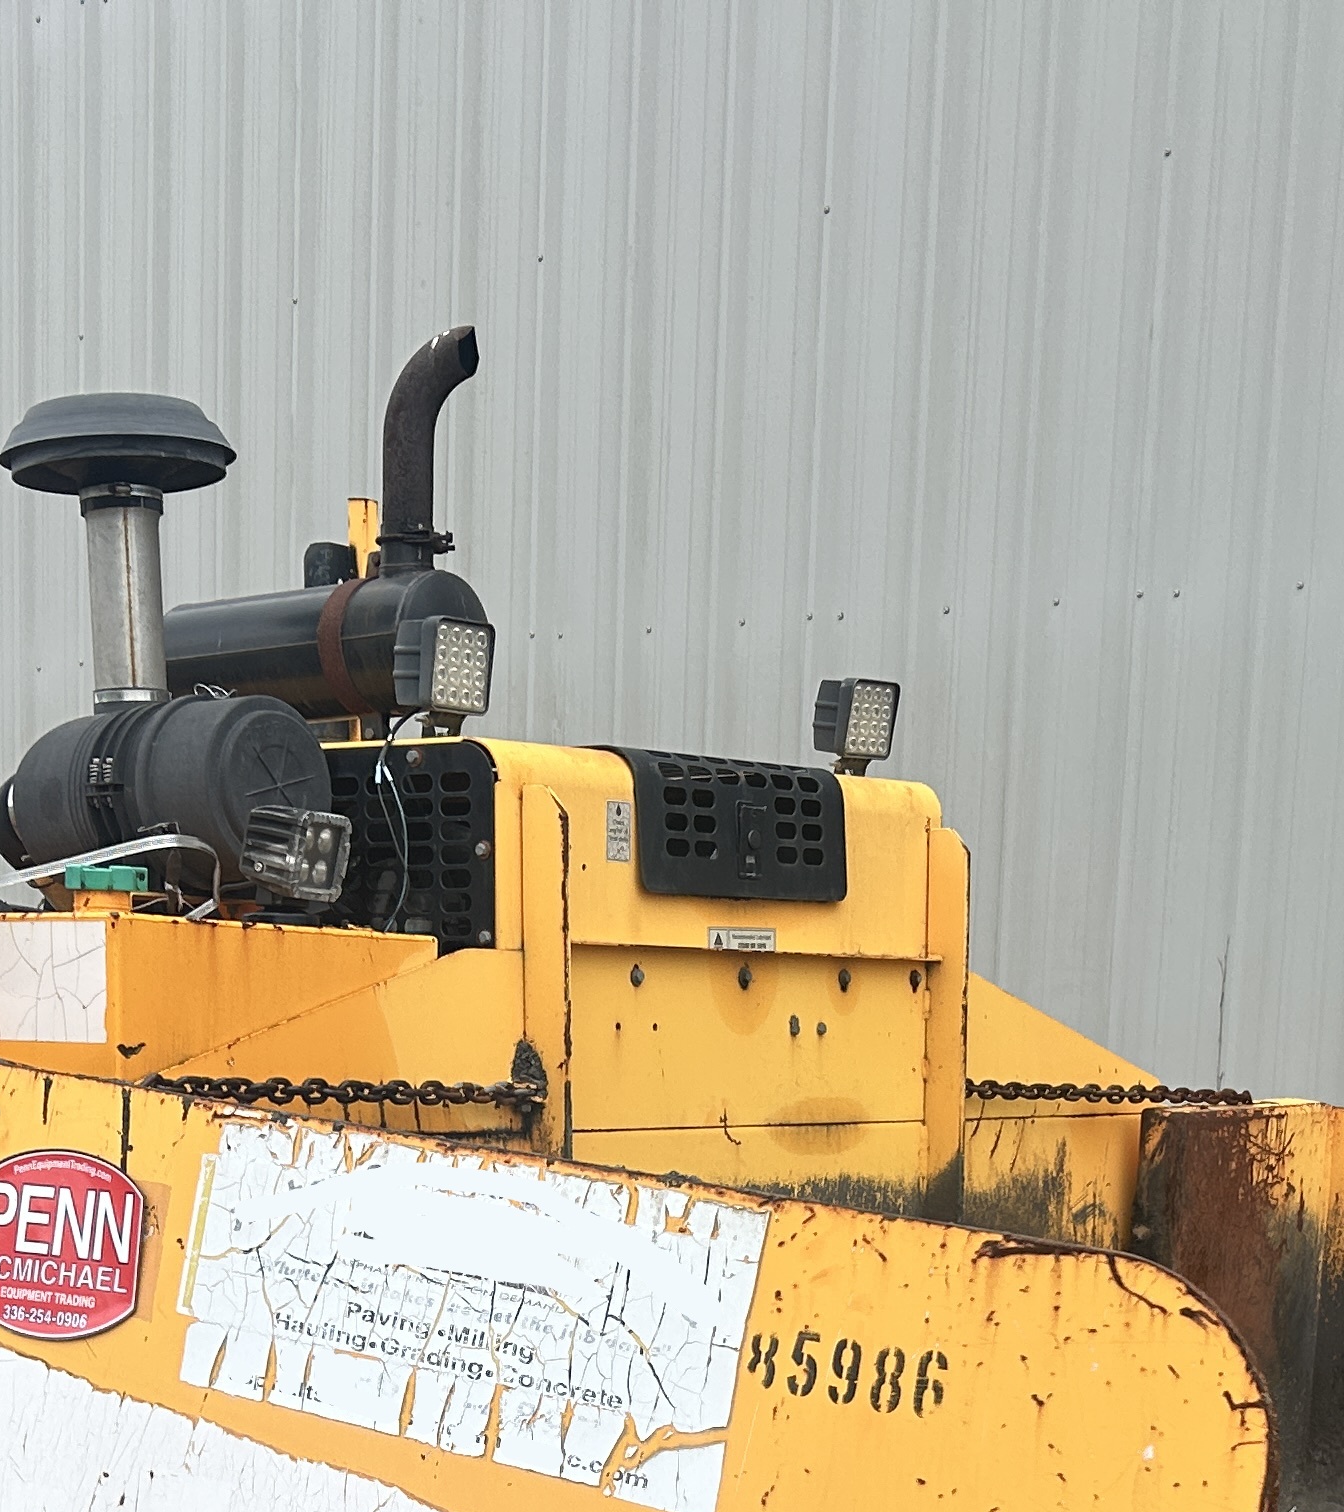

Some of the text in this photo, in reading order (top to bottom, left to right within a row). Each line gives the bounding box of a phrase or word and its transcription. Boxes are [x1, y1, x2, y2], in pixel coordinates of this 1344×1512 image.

[0, 1285, 96, 1309] EQUIPMENT TRADING
[2, 1304, 88, 1329] 336-254-0906
[347, 1301, 430, 1339] Paving
[503, 1364, 623, 1409] Concrete
[747, 1330, 948, 1418] 85986
